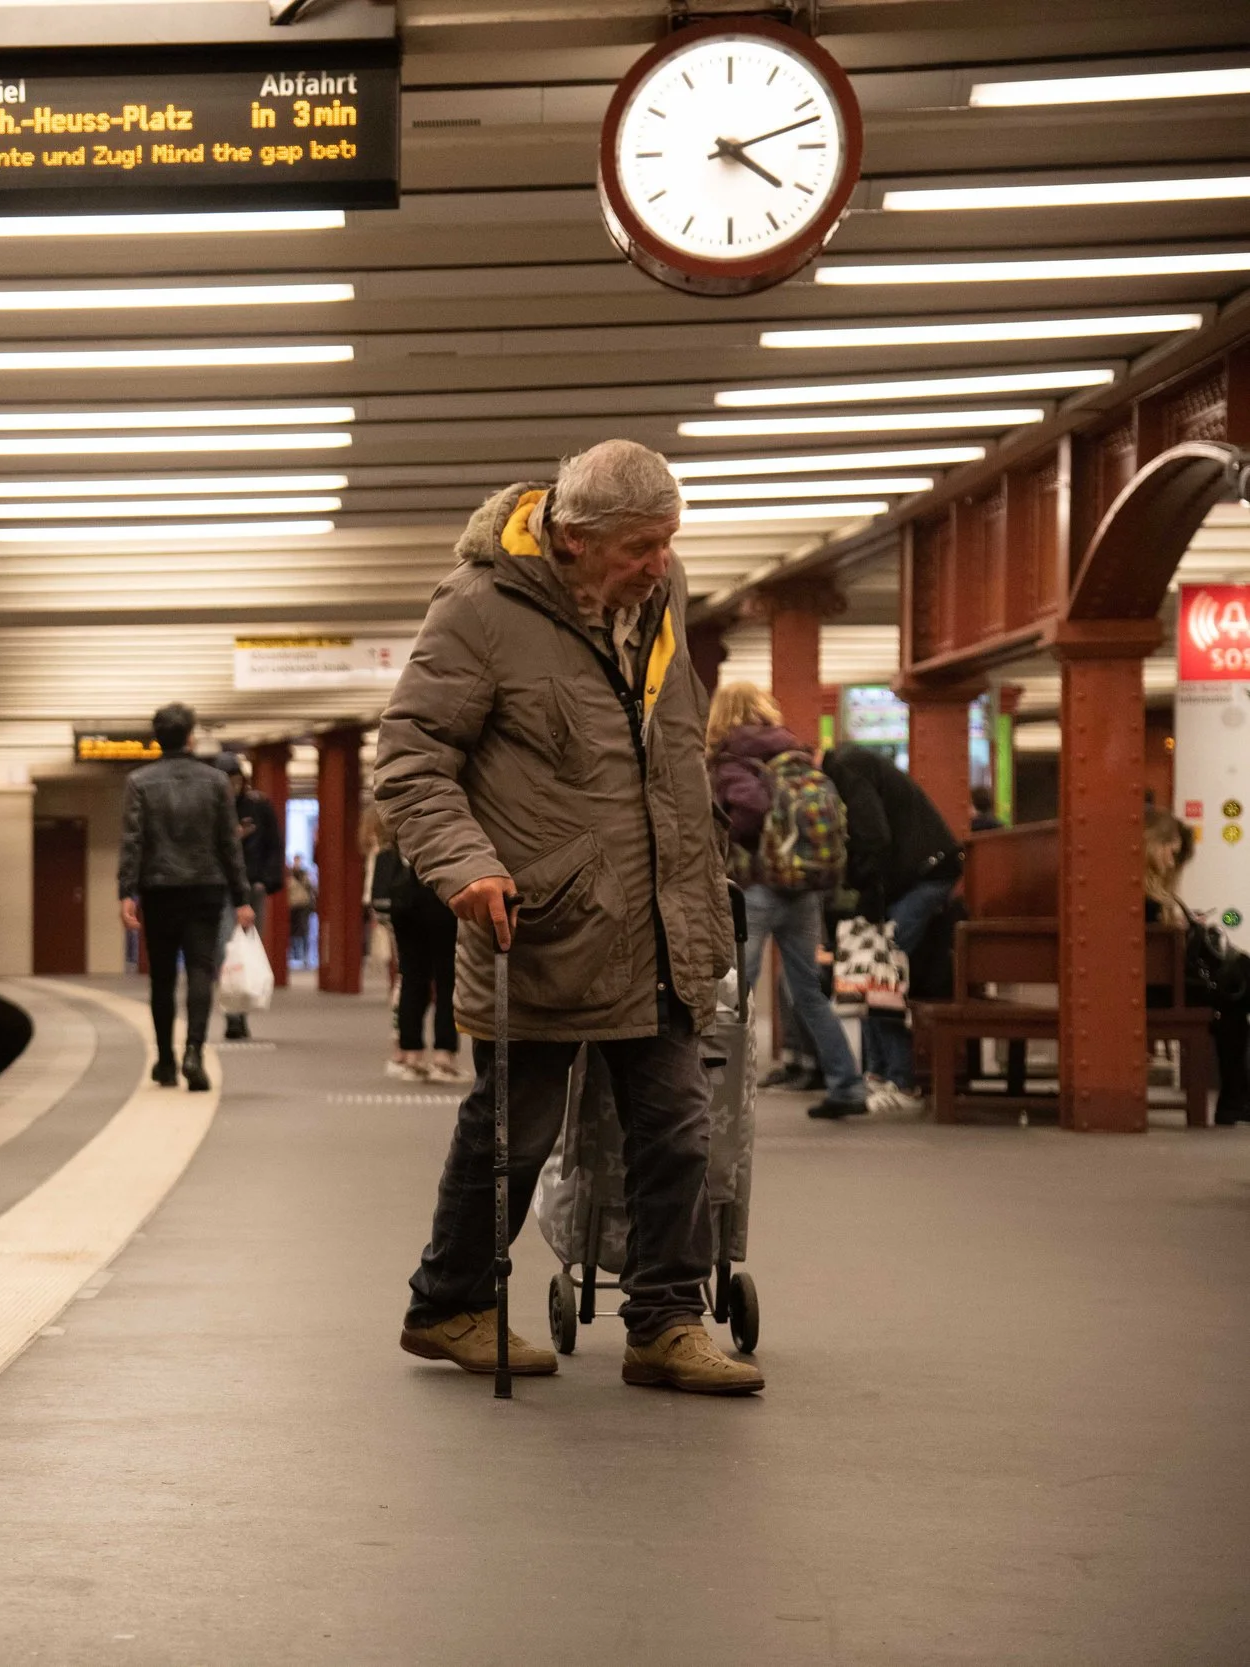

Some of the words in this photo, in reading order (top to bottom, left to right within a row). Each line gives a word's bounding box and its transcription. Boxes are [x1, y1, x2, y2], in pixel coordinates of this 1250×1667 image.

[259, 71, 358, 97] Abfahrt
[251, 101, 276, 129] in
[42, 145, 86, 167] und
[92, 144, 144, 170] Zug!
[151, 142, 205, 165] Mind
[211, 141, 253, 163] the
[259, 143, 304, 167] gap
